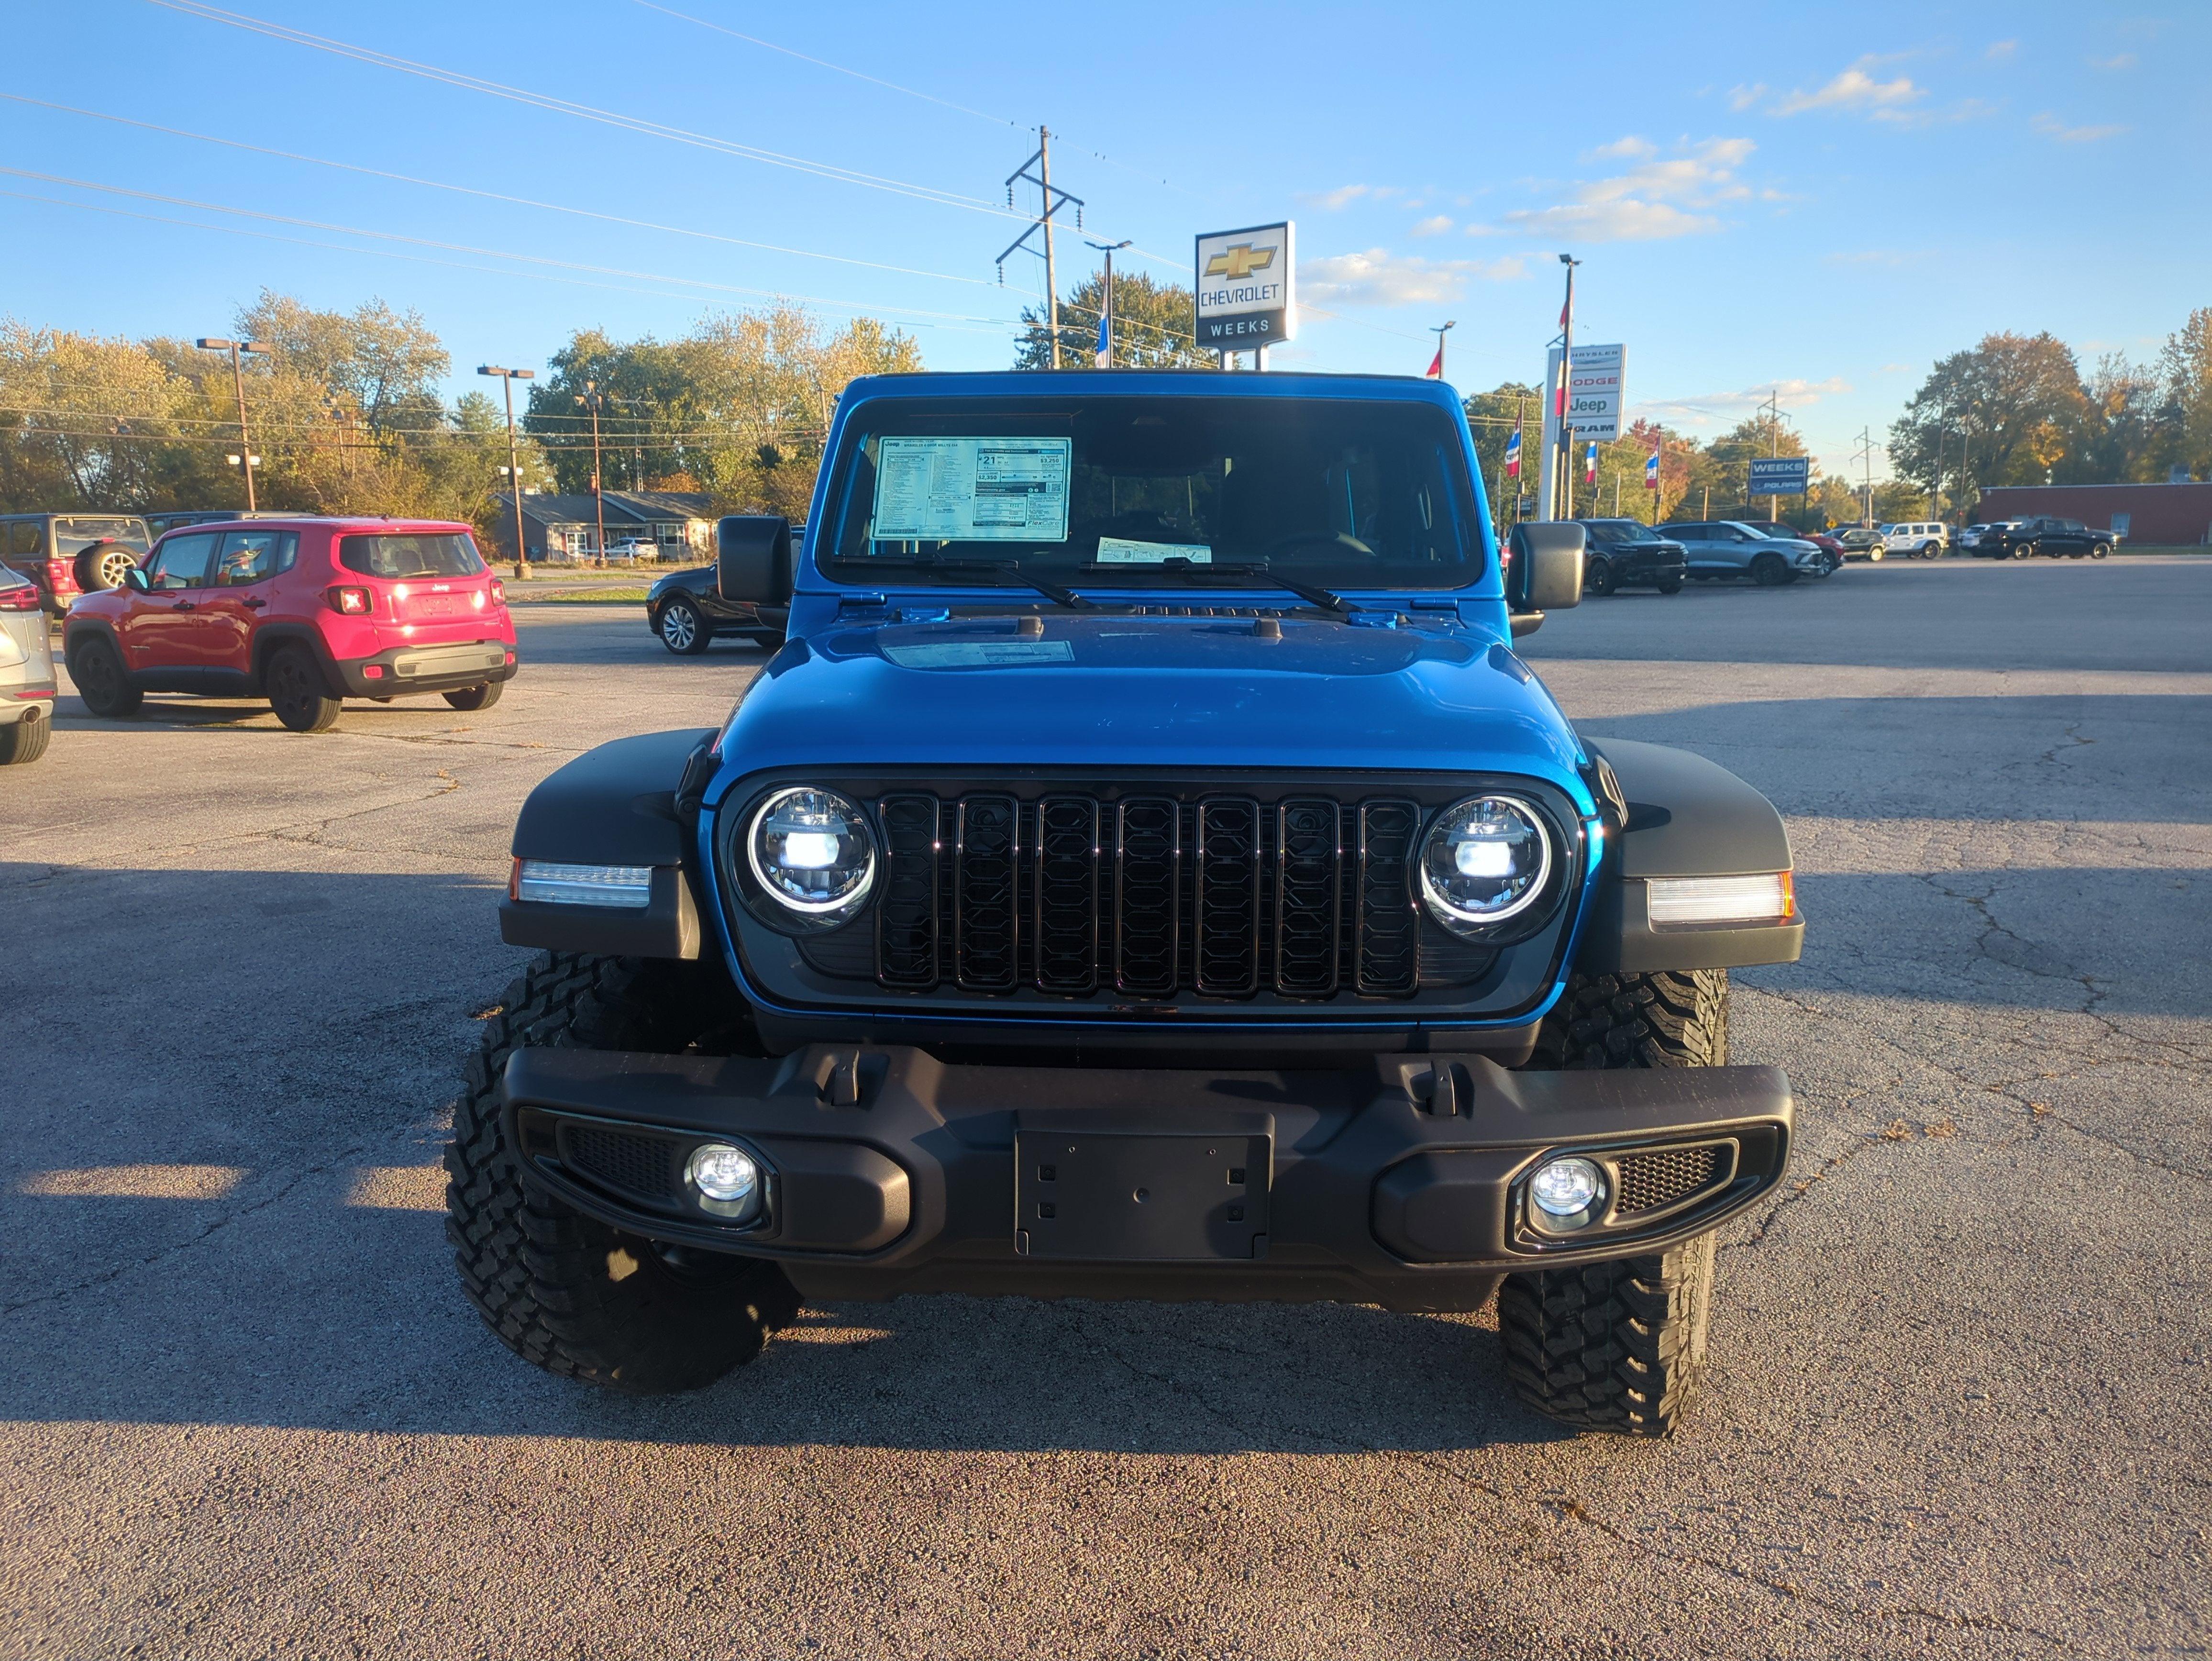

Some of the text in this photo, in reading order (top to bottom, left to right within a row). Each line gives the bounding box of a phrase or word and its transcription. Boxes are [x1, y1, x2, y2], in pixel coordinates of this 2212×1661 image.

[1201, 284, 1279, 307] CHEVROLET
[1211, 320, 1269, 336] WEEKS
[1571, 377, 1618, 386] ODGE
[1570, 398, 1607, 413] Jeep
[1574, 424, 1615, 432] RAM
[984, 456, 995, 464] 21
[1754, 463, 1804, 472] WEEKS
